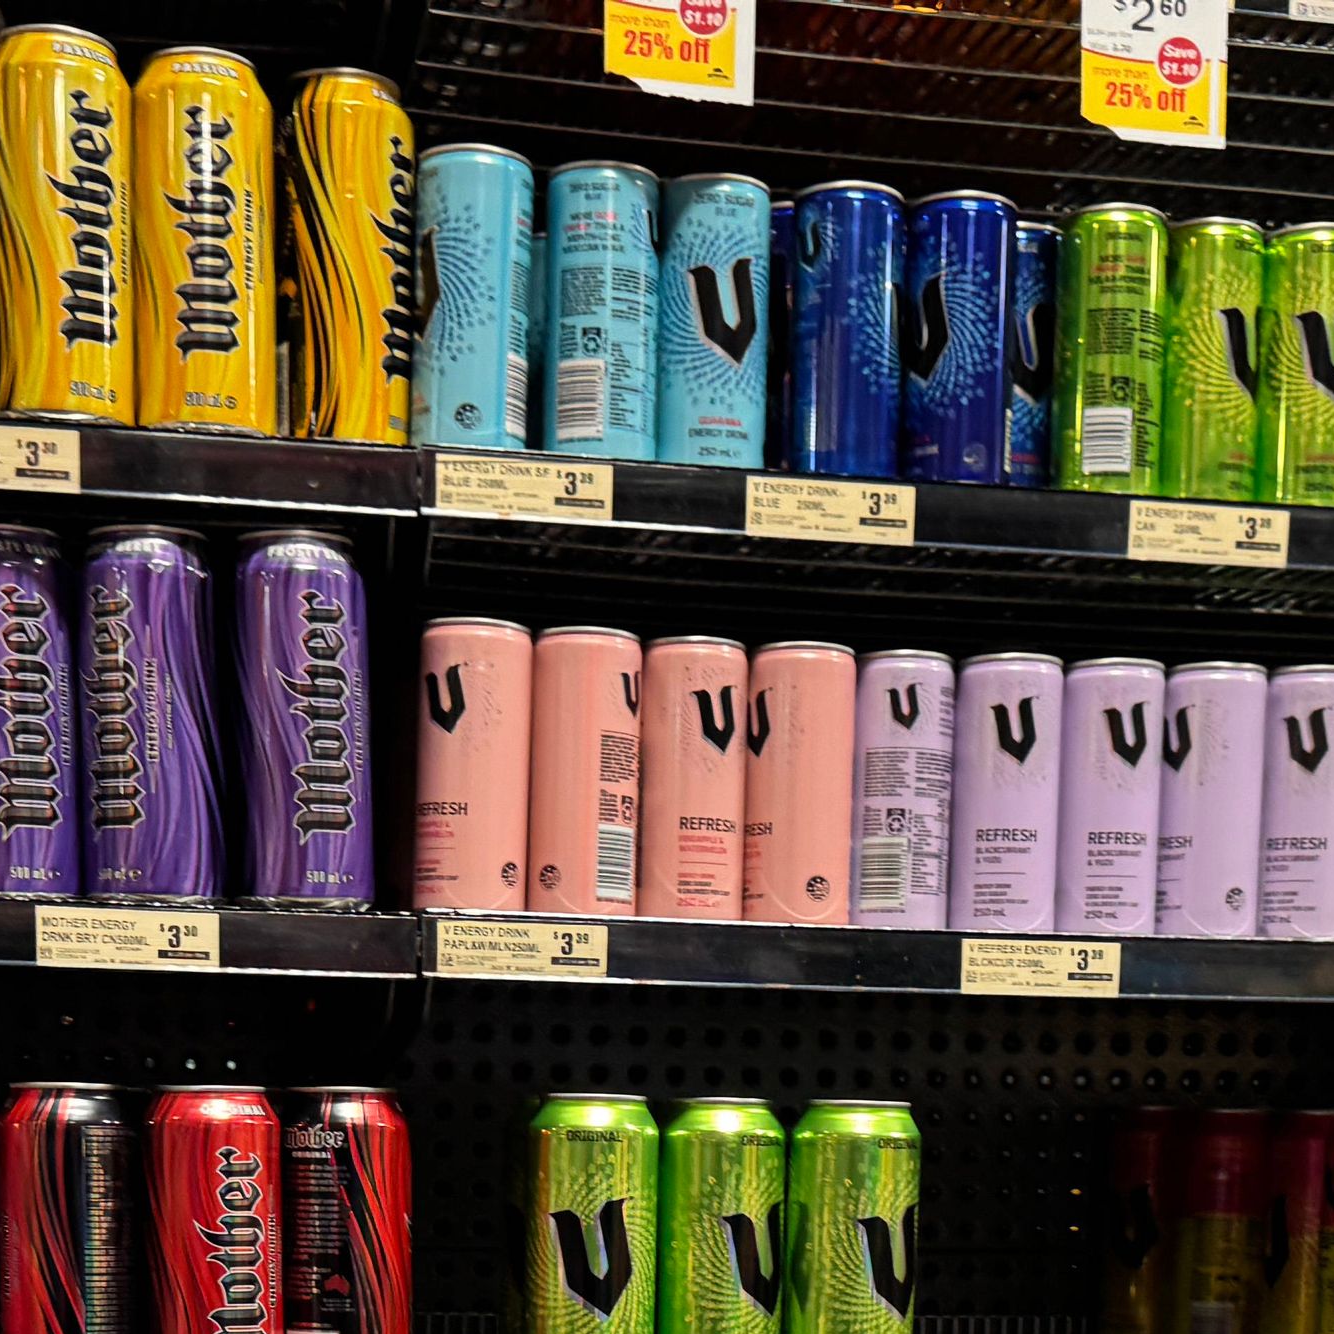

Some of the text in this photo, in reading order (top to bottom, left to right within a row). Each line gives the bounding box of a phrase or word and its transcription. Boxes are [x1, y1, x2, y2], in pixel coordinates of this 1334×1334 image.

[624, 30, 710, 63] 25% off
[1162, 43, 1198, 61] Save
[1105, 81, 1187, 113] 25% off
[679, 815, 737, 834] REFRESH
[975, 828, 1038, 844] REFRESH
[1088, 830, 1148, 847] REFRESH
